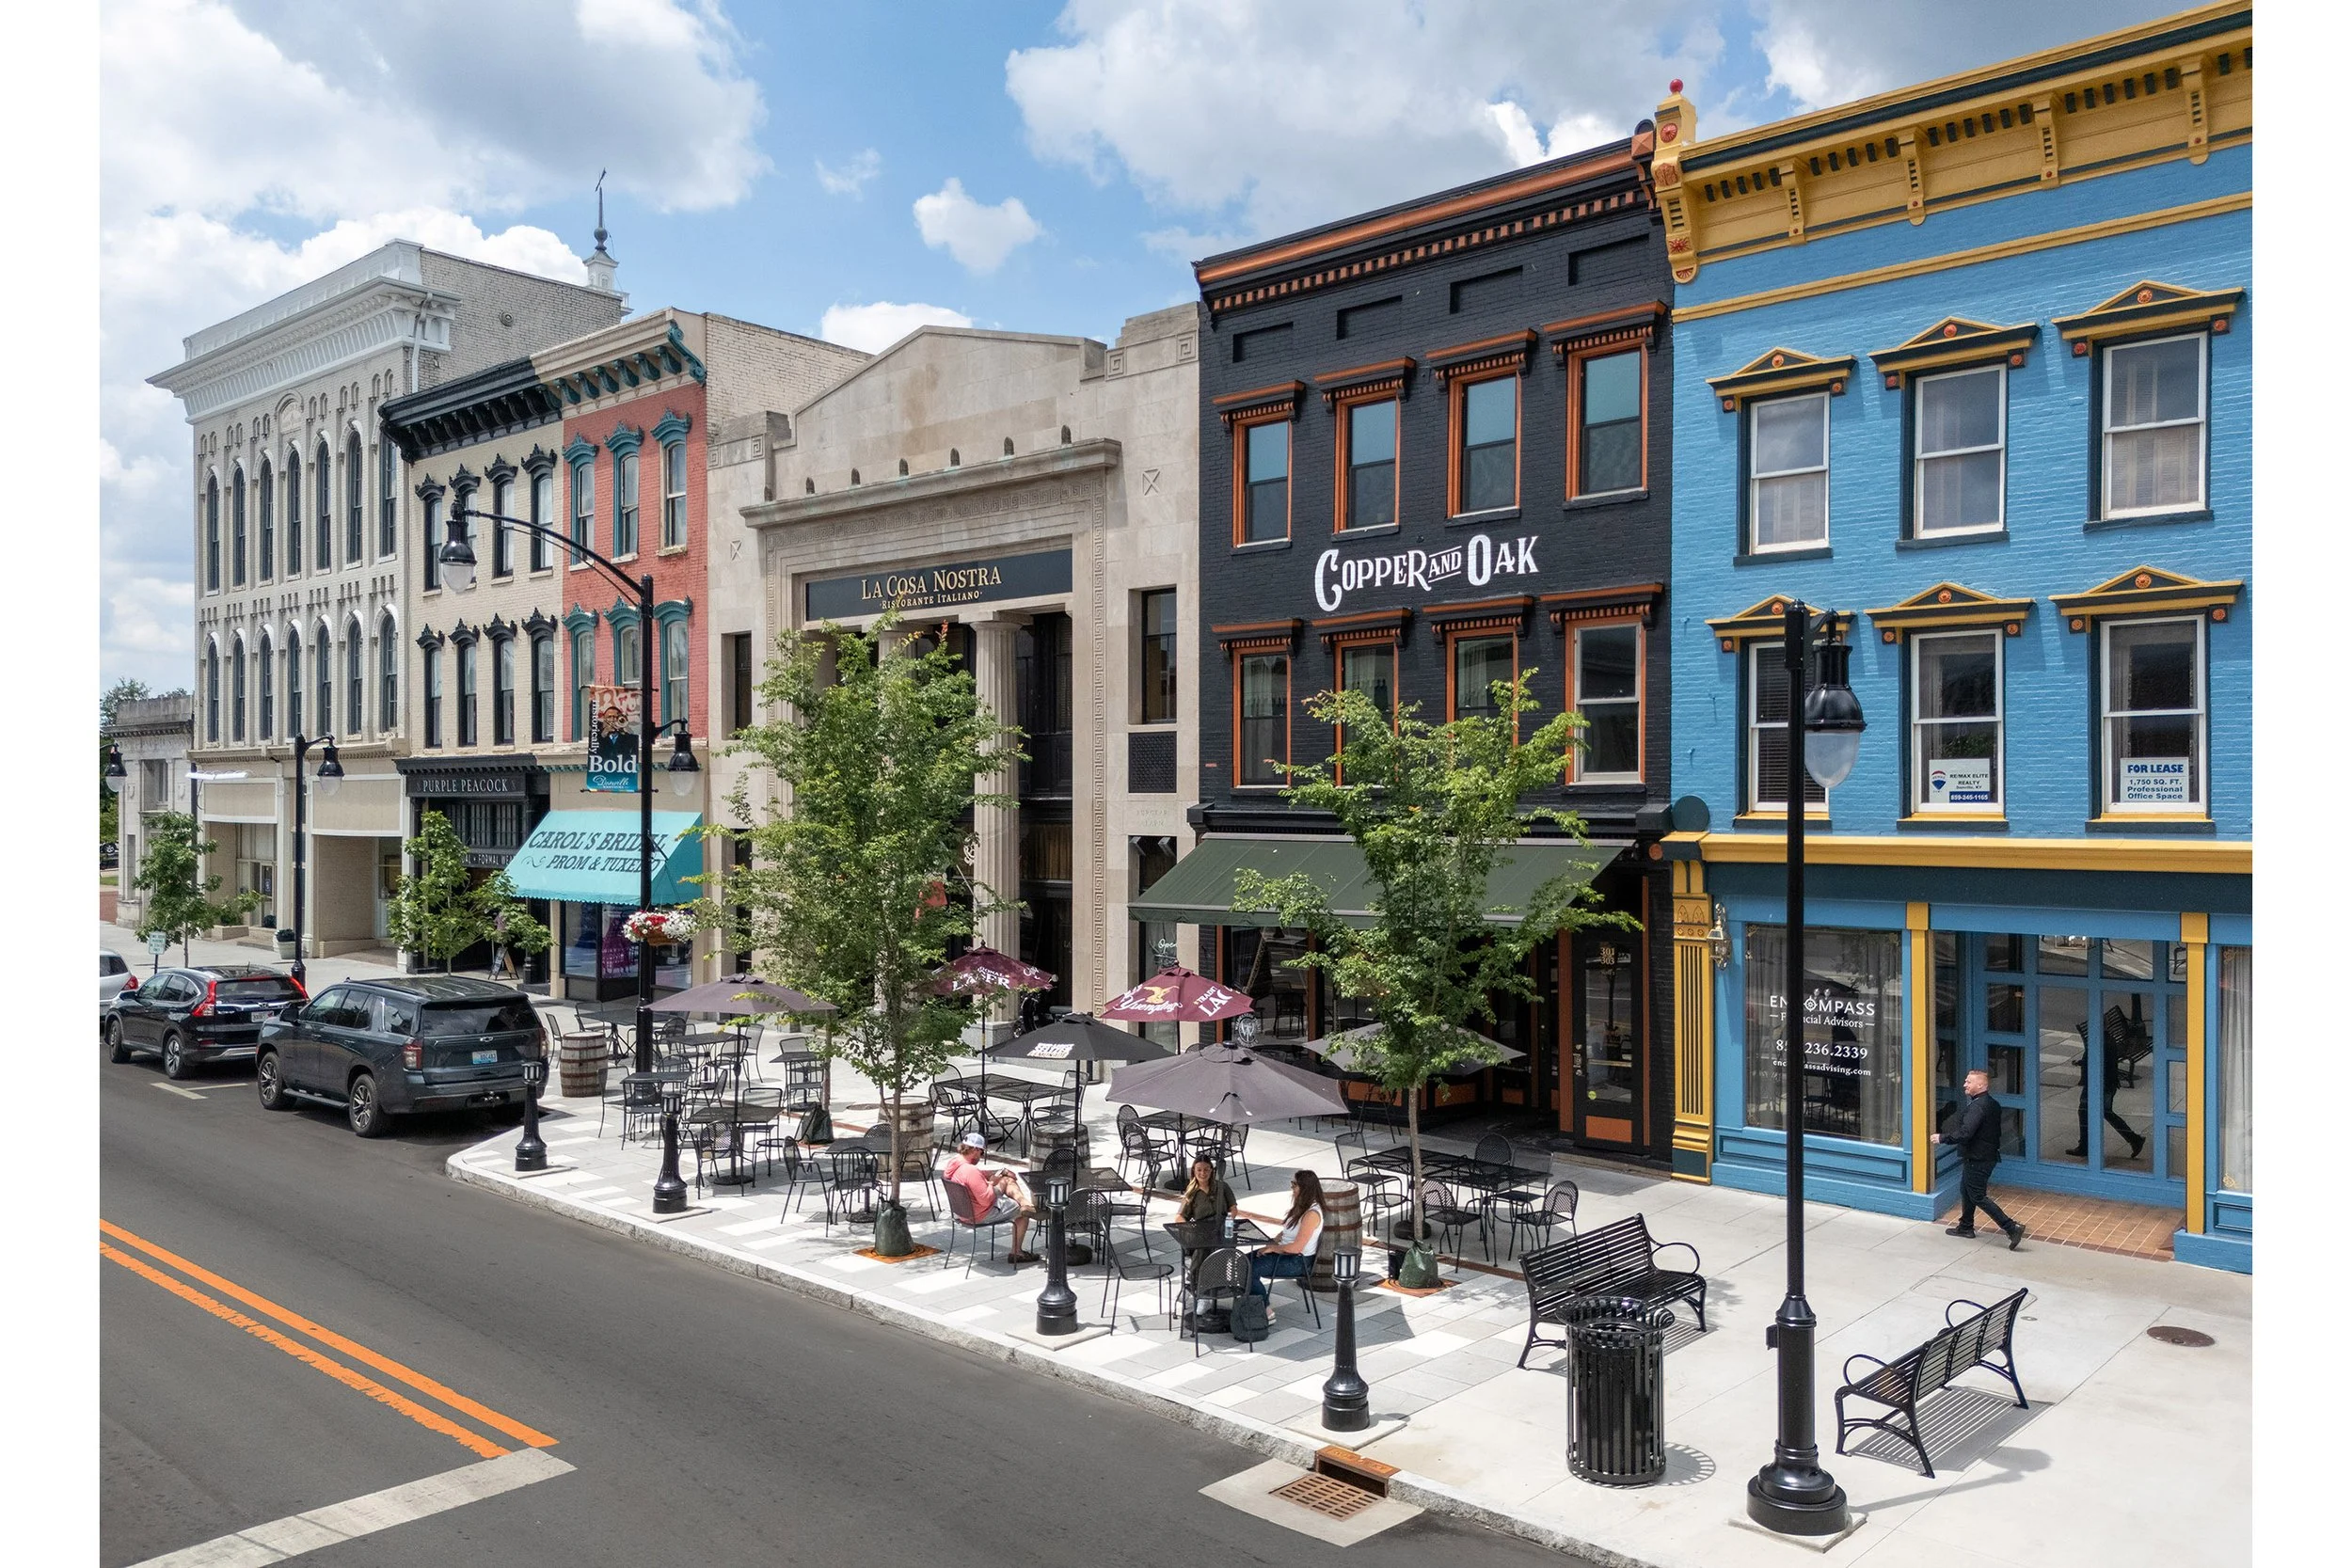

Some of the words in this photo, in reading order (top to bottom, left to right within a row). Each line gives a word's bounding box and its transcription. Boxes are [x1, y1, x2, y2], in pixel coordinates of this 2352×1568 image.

[1314, 548, 1432, 612] COPPER
[1428, 550, 1462, 579] AND
[1467, 533, 1540, 587] OAK
[861, 578, 883, 600] LA
[886, 575, 928, 597] COSA
[932, 565, 1002, 593] NOSTRA
[937, 590, 979, 603] ITALIANO
[588, 753, 638, 773] Bold
[2127, 764, 2148, 773] FOR
[2150, 764, 2185, 773] LEASE
[422, 779, 457, 792] PURPLE
[461, 778, 508, 792] PEACOCK
[528, 831, 601, 850] CAROL'S
[596, 832, 669, 852] BRIDL
[546, 854, 586, 870] PROM
[588, 856, 601, 871] &
[1157, 938, 1178, 955] Ope
[1770, 994, 1876, 1017] ENOMPASS
[1823, 1016, 1864, 1029] Advisors
[1775, 1038, 1868, 1059] 8236.2339
